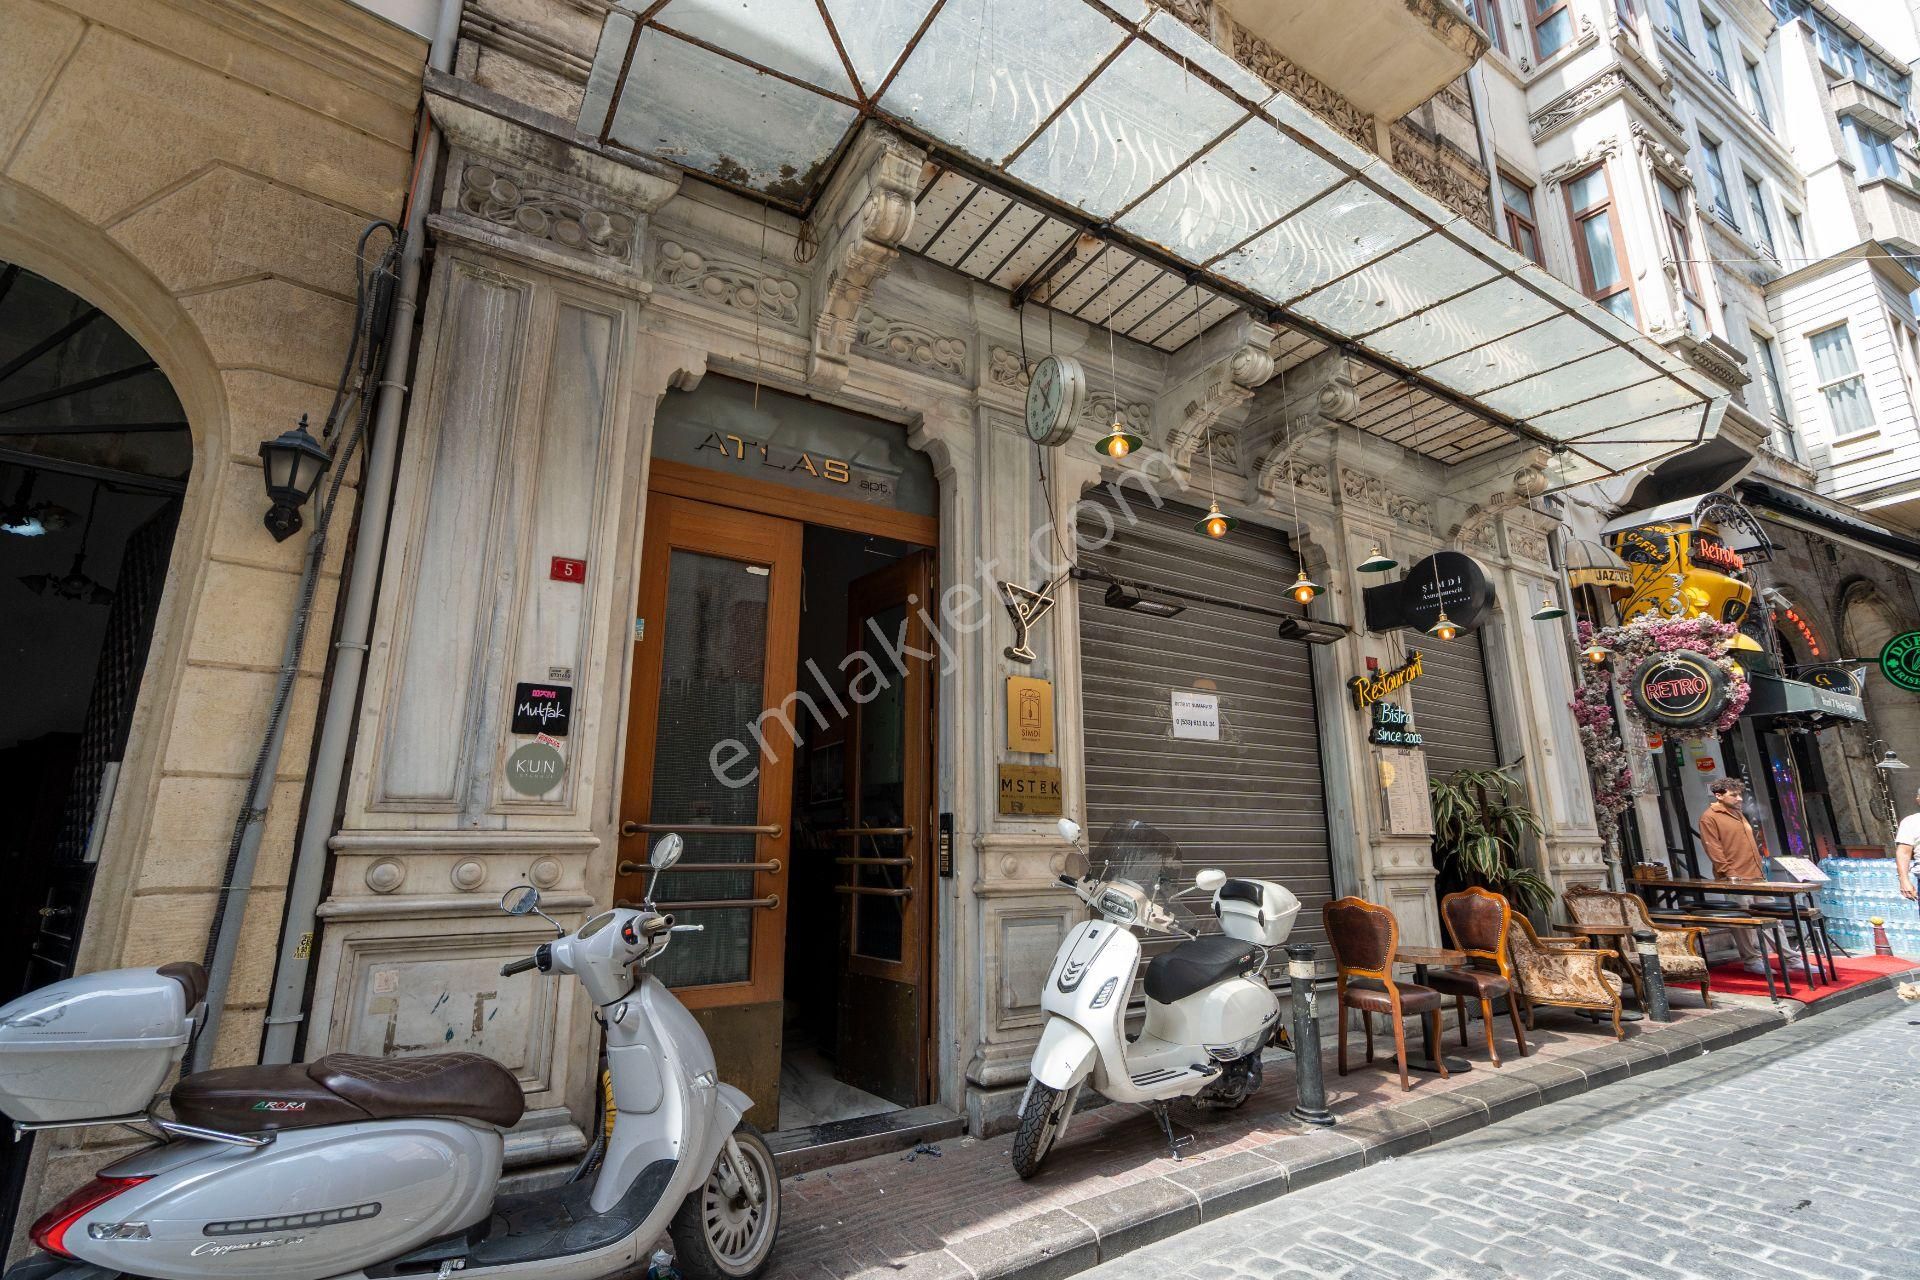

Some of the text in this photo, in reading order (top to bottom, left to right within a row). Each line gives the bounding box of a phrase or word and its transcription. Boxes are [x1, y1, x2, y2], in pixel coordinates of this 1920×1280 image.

[694, 431, 892, 496] ATLAS apt.
[1627, 532, 1665, 561] COFFEE
[564, 563, 574, 576] 5
[1355, 650, 1423, 707] Restaurant
[1646, 676, 1707, 700] RETRO
[517, 701, 566, 726] Mutfak
[1380, 703, 1412, 724] Bistro
[1377, 726, 1423, 744] since 2003
[516, 759, 555, 774] KUN
[252, 1101, 306, 1110] ARORA
